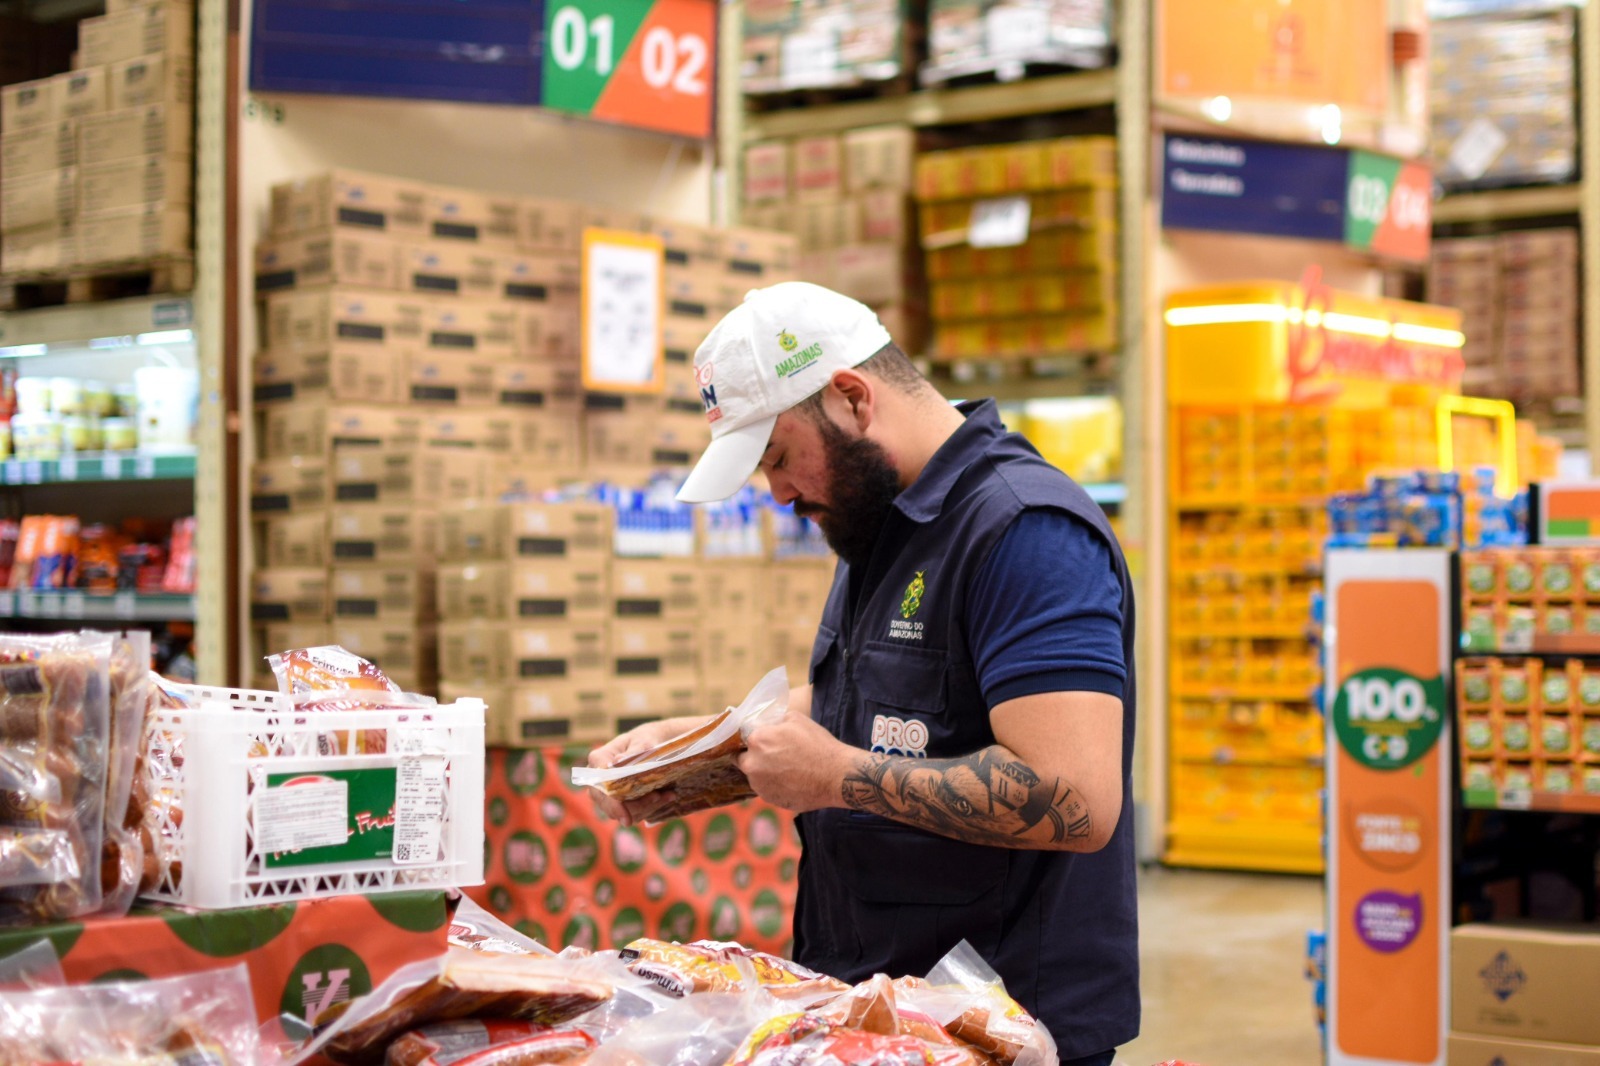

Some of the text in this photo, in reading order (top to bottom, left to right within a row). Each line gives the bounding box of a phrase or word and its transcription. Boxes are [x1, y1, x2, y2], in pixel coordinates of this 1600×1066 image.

[551, 5, 614, 76] 01
[641, 26, 708, 97] 02
[774, 342, 823, 378] AMAZONAS
[889, 629, 923, 640] AMAZONAS
[890, 620, 924, 631] GOVERNO DO
[871, 714, 929, 750] PRO
